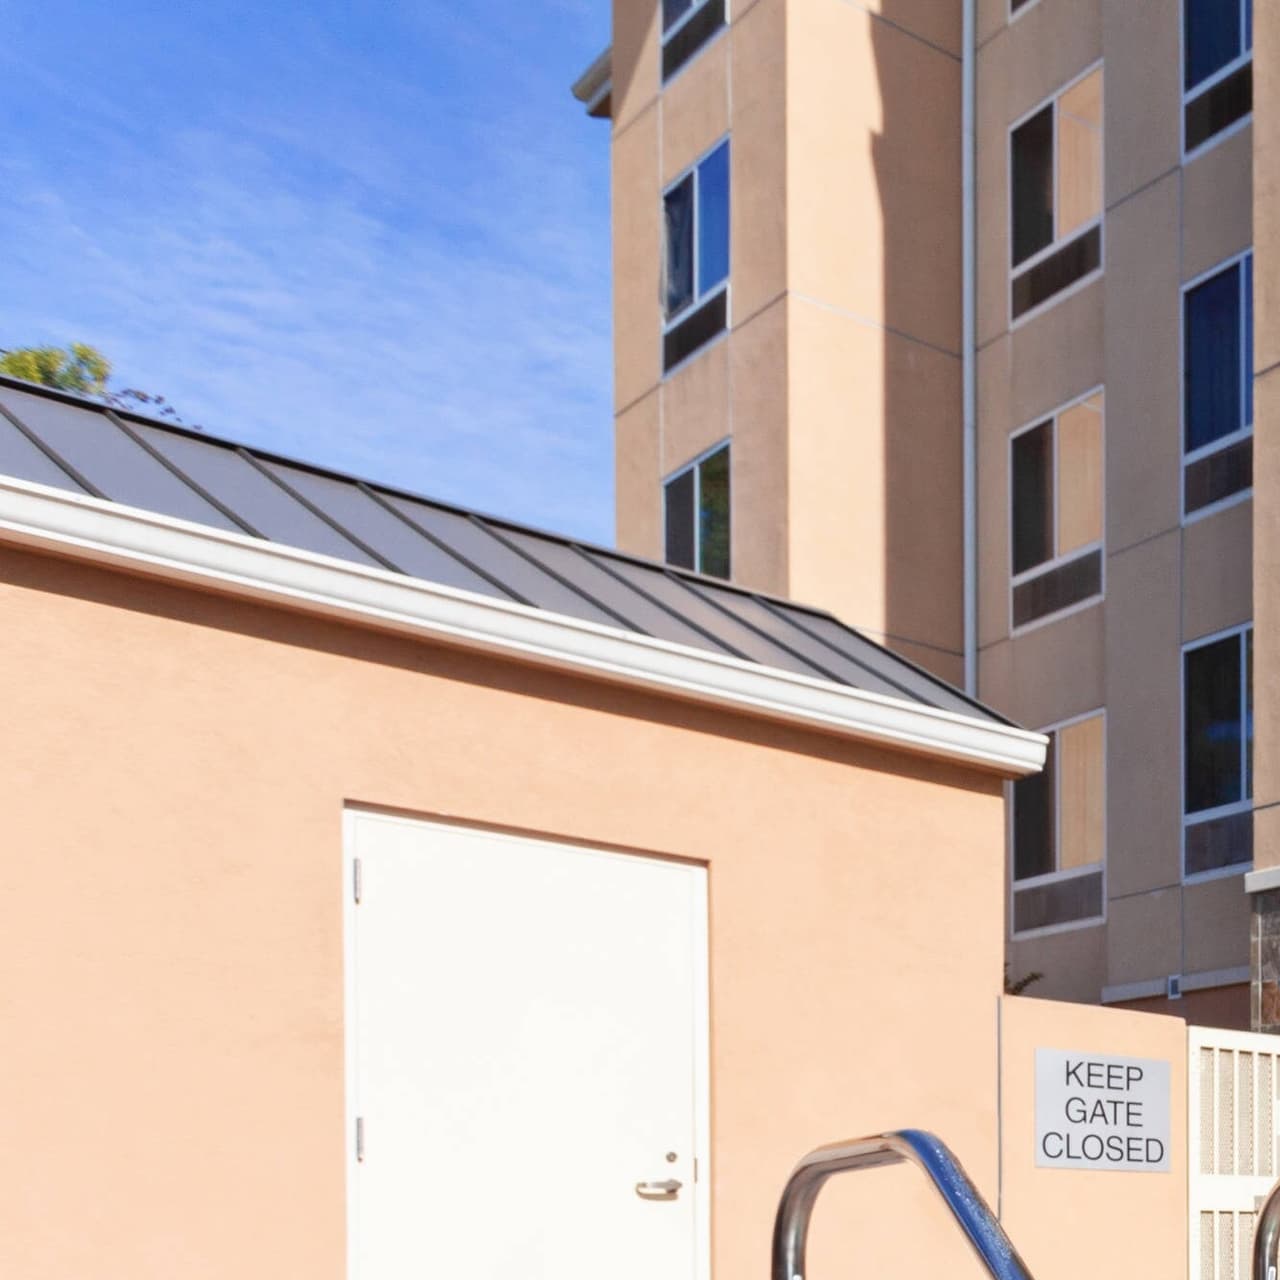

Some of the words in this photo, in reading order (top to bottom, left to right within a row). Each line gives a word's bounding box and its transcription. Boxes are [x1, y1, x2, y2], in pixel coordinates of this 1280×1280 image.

[1066, 1060, 1143, 1091] KEEP
[1065, 1097, 1143, 1128] GATE
[1042, 1132, 1164, 1163] CLOSED
